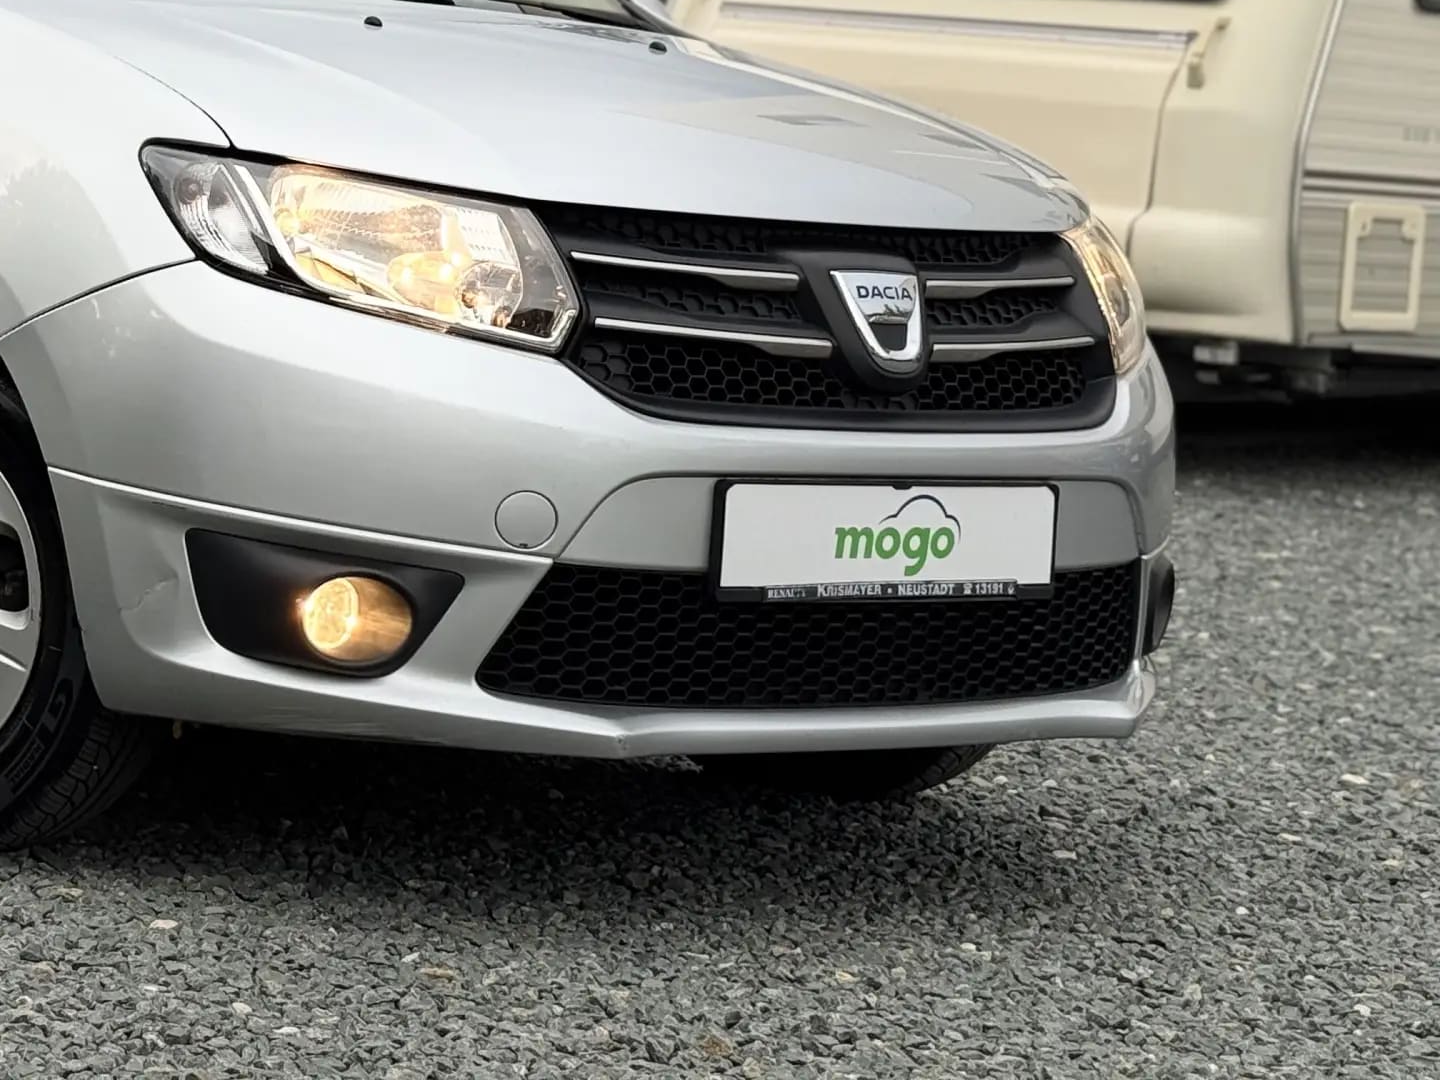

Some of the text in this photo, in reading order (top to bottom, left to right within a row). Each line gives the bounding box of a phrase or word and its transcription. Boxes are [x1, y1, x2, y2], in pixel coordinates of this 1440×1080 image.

[855, 285, 913, 301] DACIA
[834, 527, 955, 577] mogo
[897, 583, 955, 597] NEUSTADT
